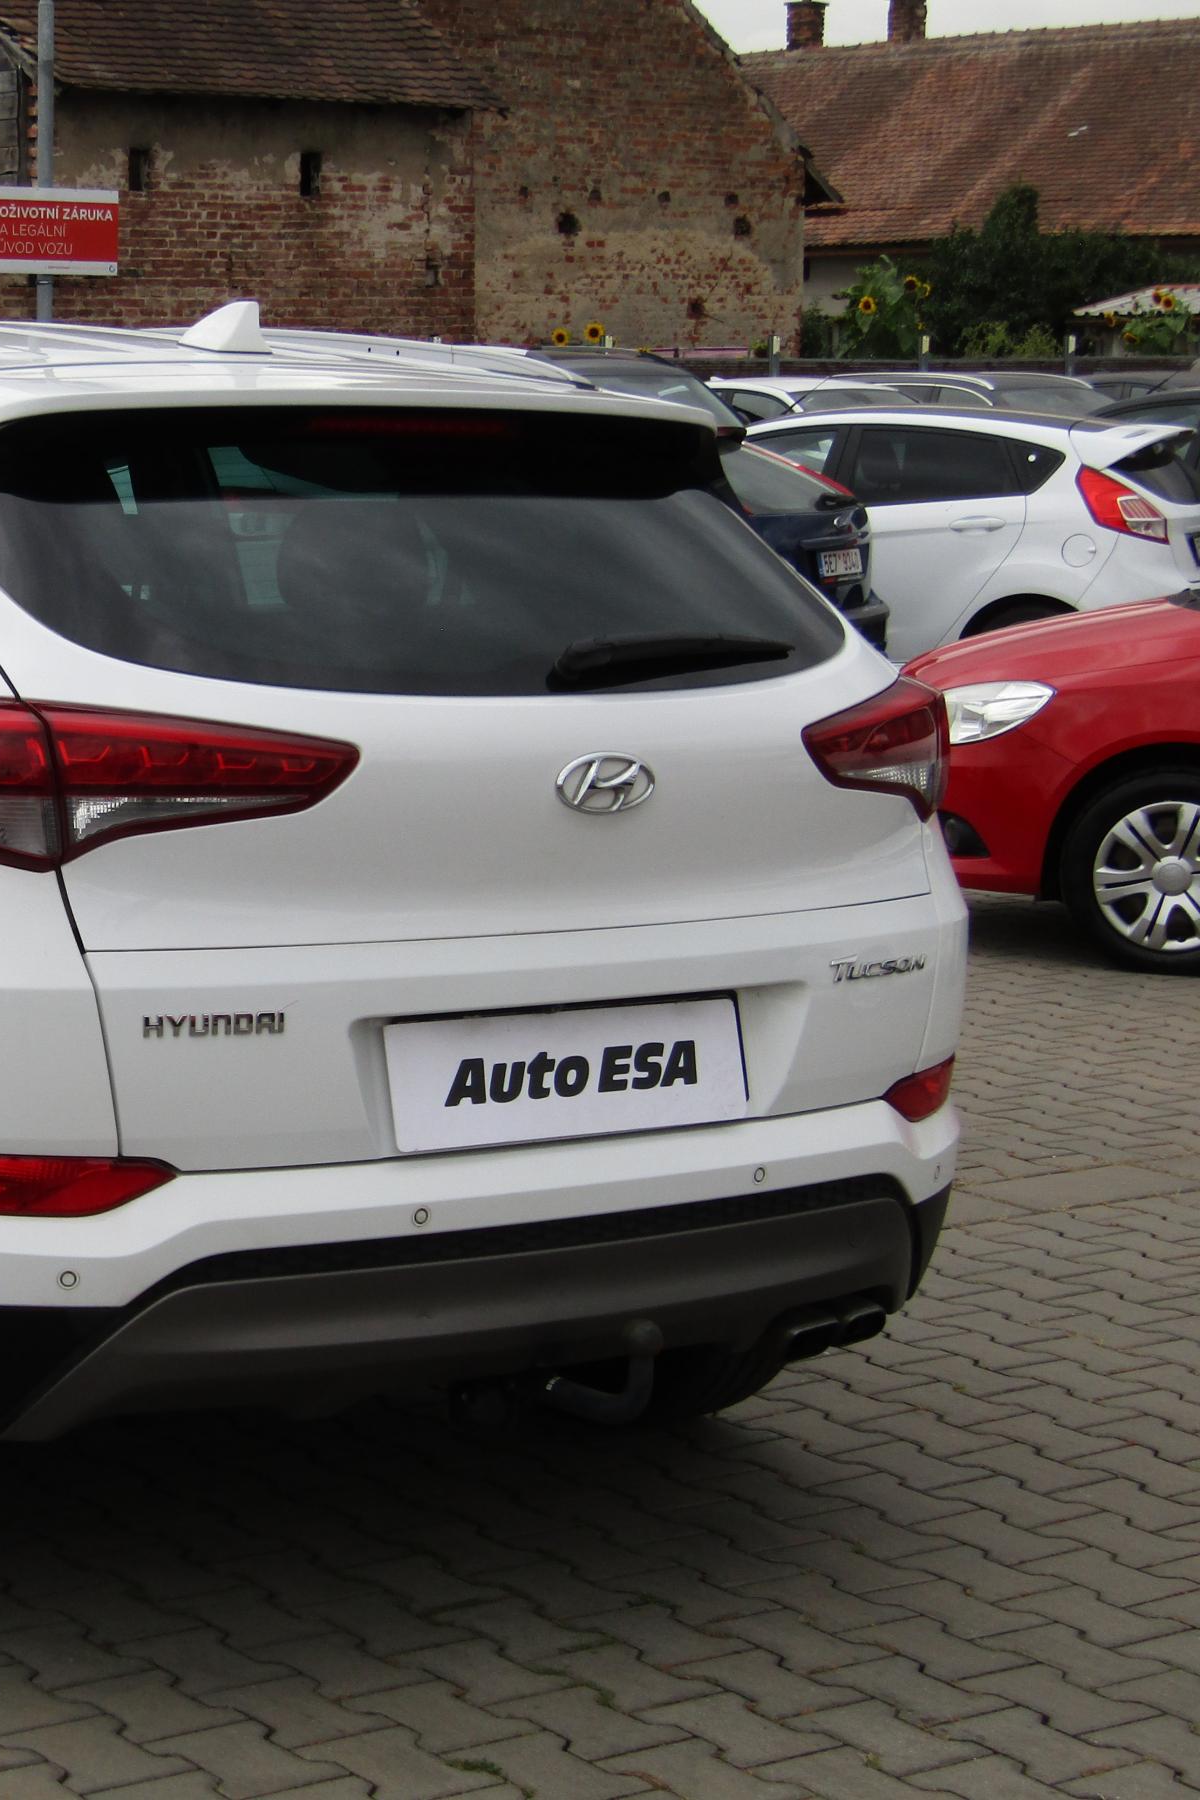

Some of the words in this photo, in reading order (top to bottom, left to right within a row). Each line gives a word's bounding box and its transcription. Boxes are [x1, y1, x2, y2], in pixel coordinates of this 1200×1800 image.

[63, 206, 113, 221] ZÁRUKA
[12, 223, 66, 237] LEGÁLNÍ
[38, 242, 73, 255] VOZU
[143, 1011, 285, 1038] HYUNDAI
[444, 1051, 590, 1107] Auto
[597, 1040, 698, 1093] ESA
